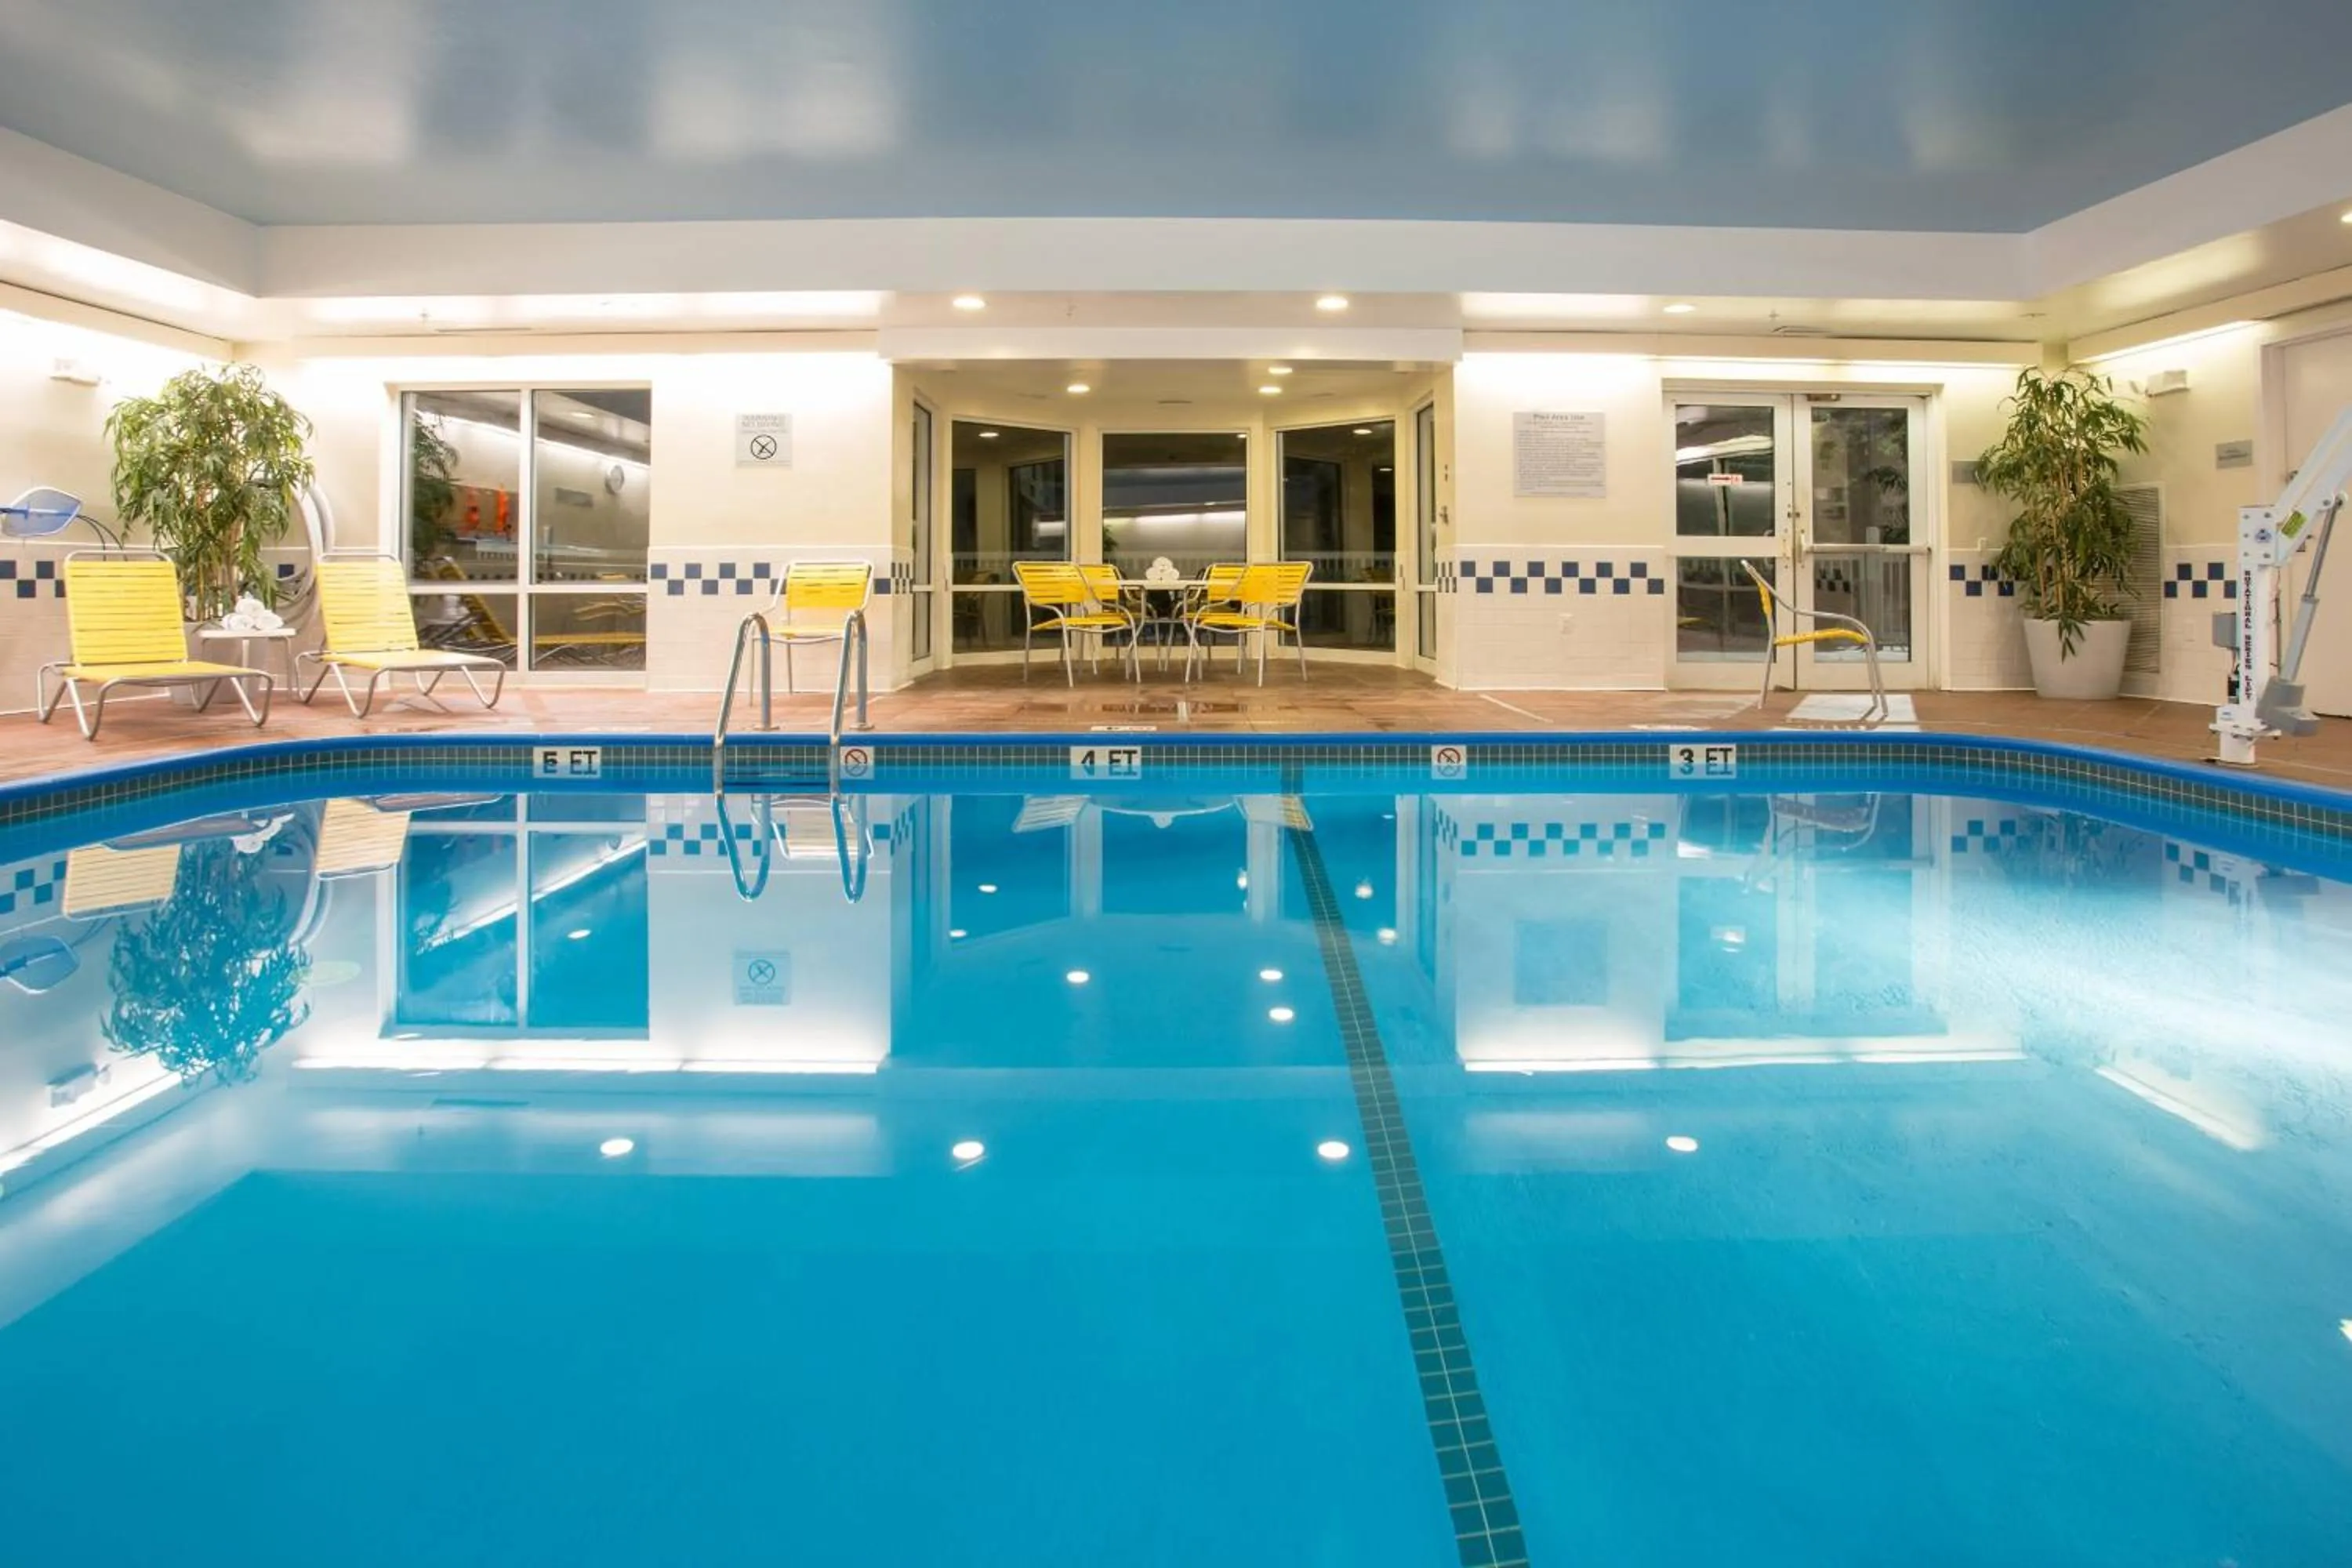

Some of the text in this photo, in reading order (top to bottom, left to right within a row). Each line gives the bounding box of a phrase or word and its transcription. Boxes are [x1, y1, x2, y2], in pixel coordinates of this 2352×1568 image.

[570, 750, 597, 766] FT
[1109, 750, 1138, 766] FT
[1679, 747, 1733, 764] 3 FT
